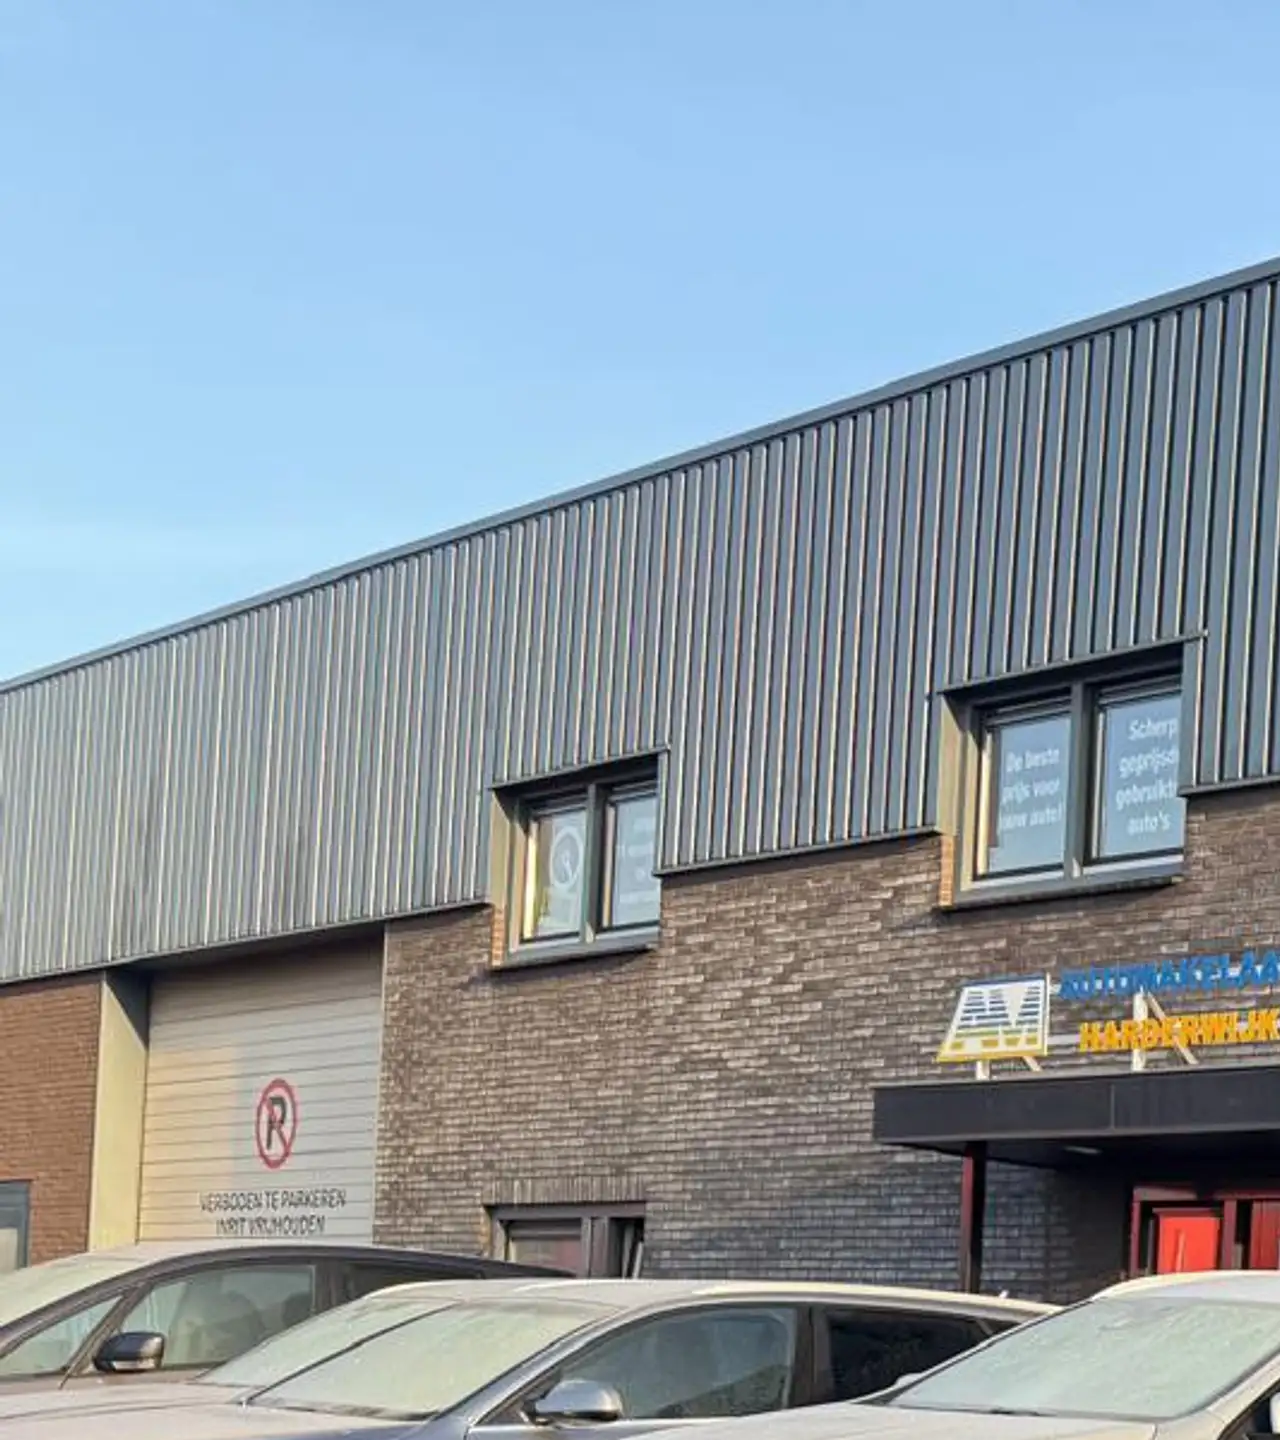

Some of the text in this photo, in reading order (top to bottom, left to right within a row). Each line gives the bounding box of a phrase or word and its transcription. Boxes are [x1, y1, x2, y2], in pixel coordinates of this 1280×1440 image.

[1116, 779, 1177, 811] gebruikt
[201, 1187, 347, 1213] VERBODEN TE PARKEREN
